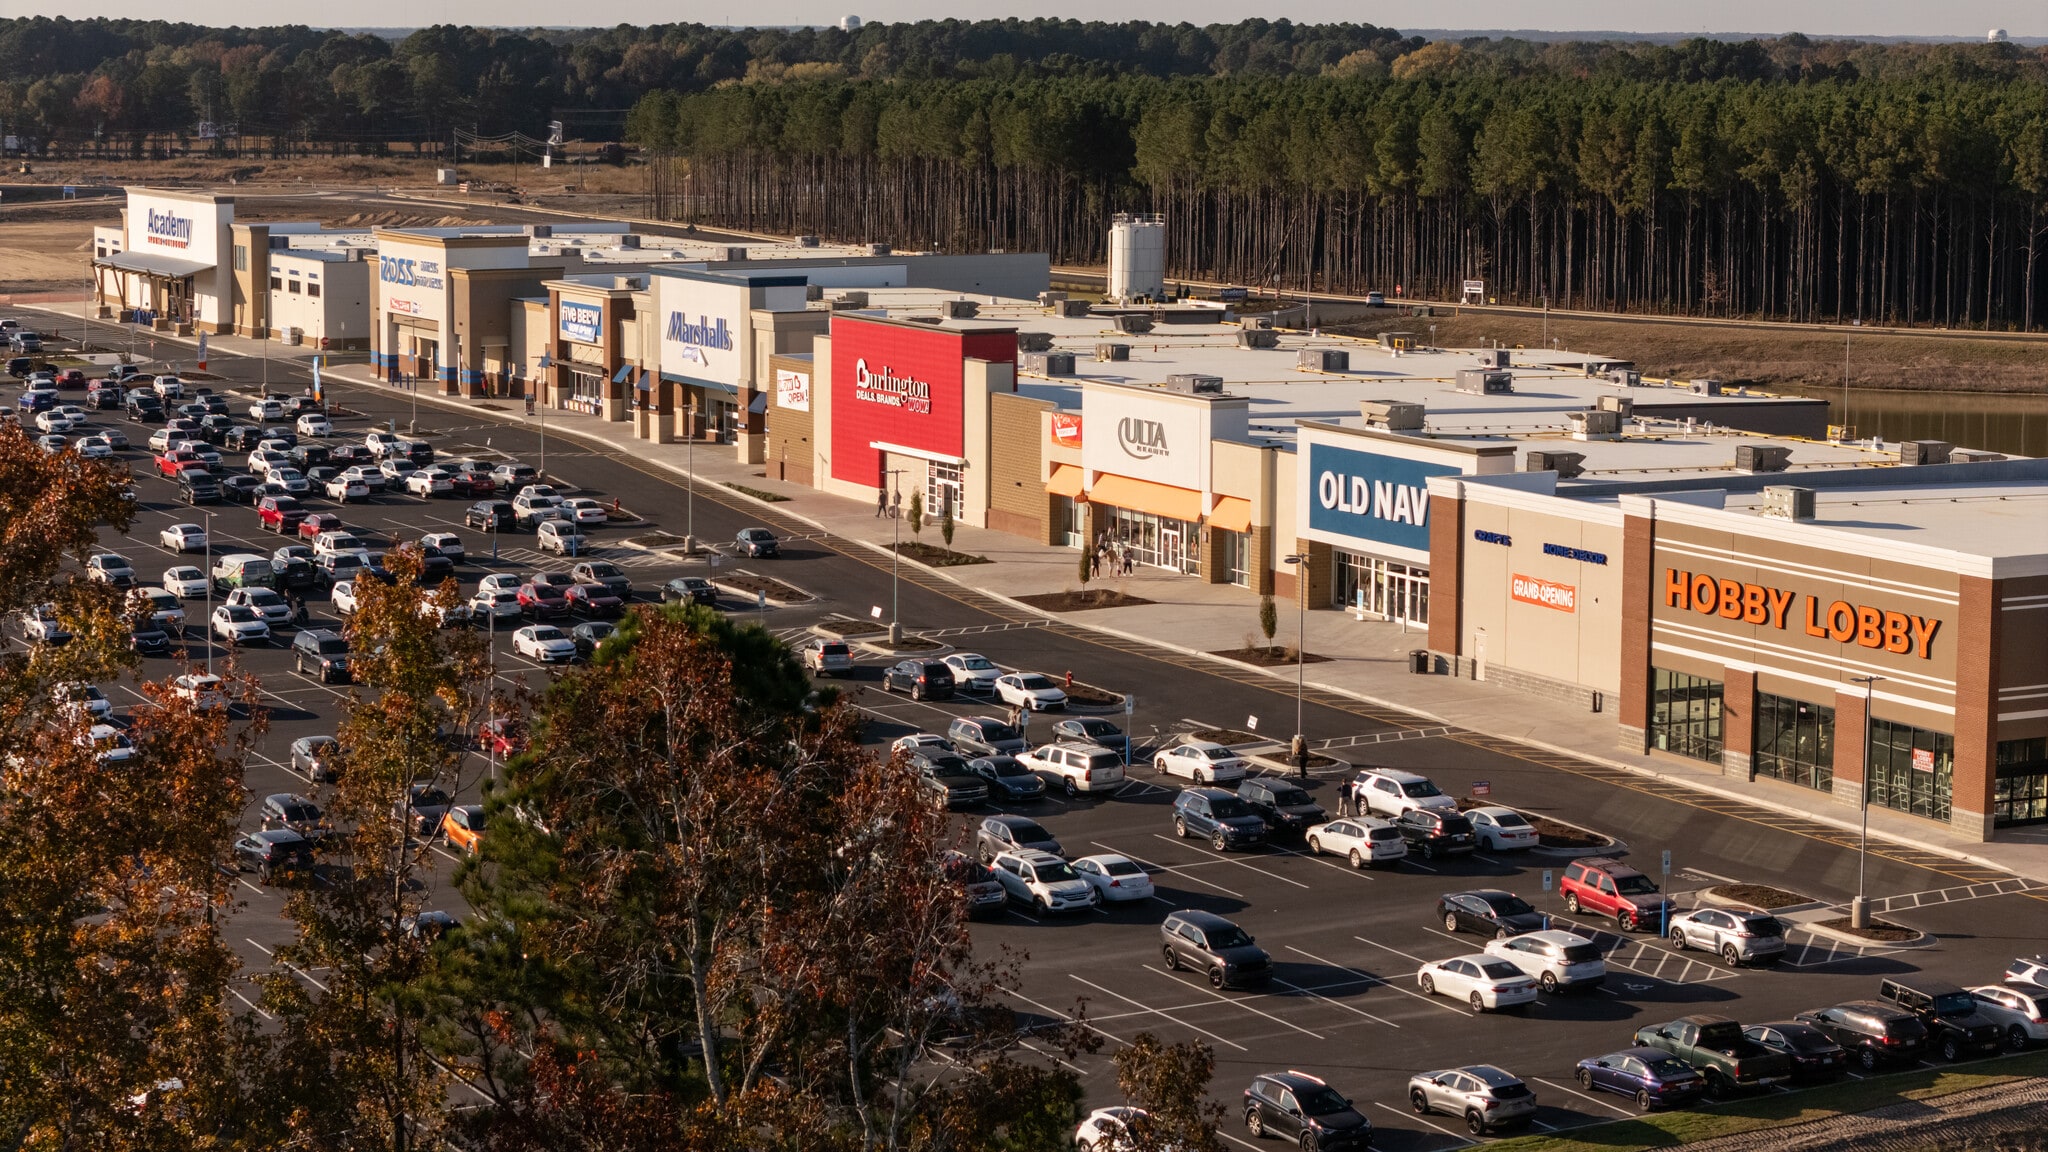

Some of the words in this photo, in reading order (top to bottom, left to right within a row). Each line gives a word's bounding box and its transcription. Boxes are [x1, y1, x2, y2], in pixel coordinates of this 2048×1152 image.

[148, 208, 191, 246] Academy
[381, 255, 416, 286] ROSS
[666, 311, 732, 350] Marshalls
[856, 358, 929, 403] Burlington
[856, 390, 876, 402] DEALS.
[876, 393, 902, 407] BRANDS.
[908, 397, 930, 414] WOW!
[1124, 417, 1168, 449] ULTA
[1319, 470, 1370, 515] OLD
[1374, 480, 1428, 526] NAV
[1474, 529, 1512, 547] CRAFTS
[1543, 543, 1570, 558] HOME
[1571, 548, 1607, 566] DECOR
[1513, 579, 1539, 600] GRAND
[1540, 585, 1573, 608] OPENING
[1665, 568, 1794, 630] HOBBY
[1805, 595, 1940, 659] LOBBY
